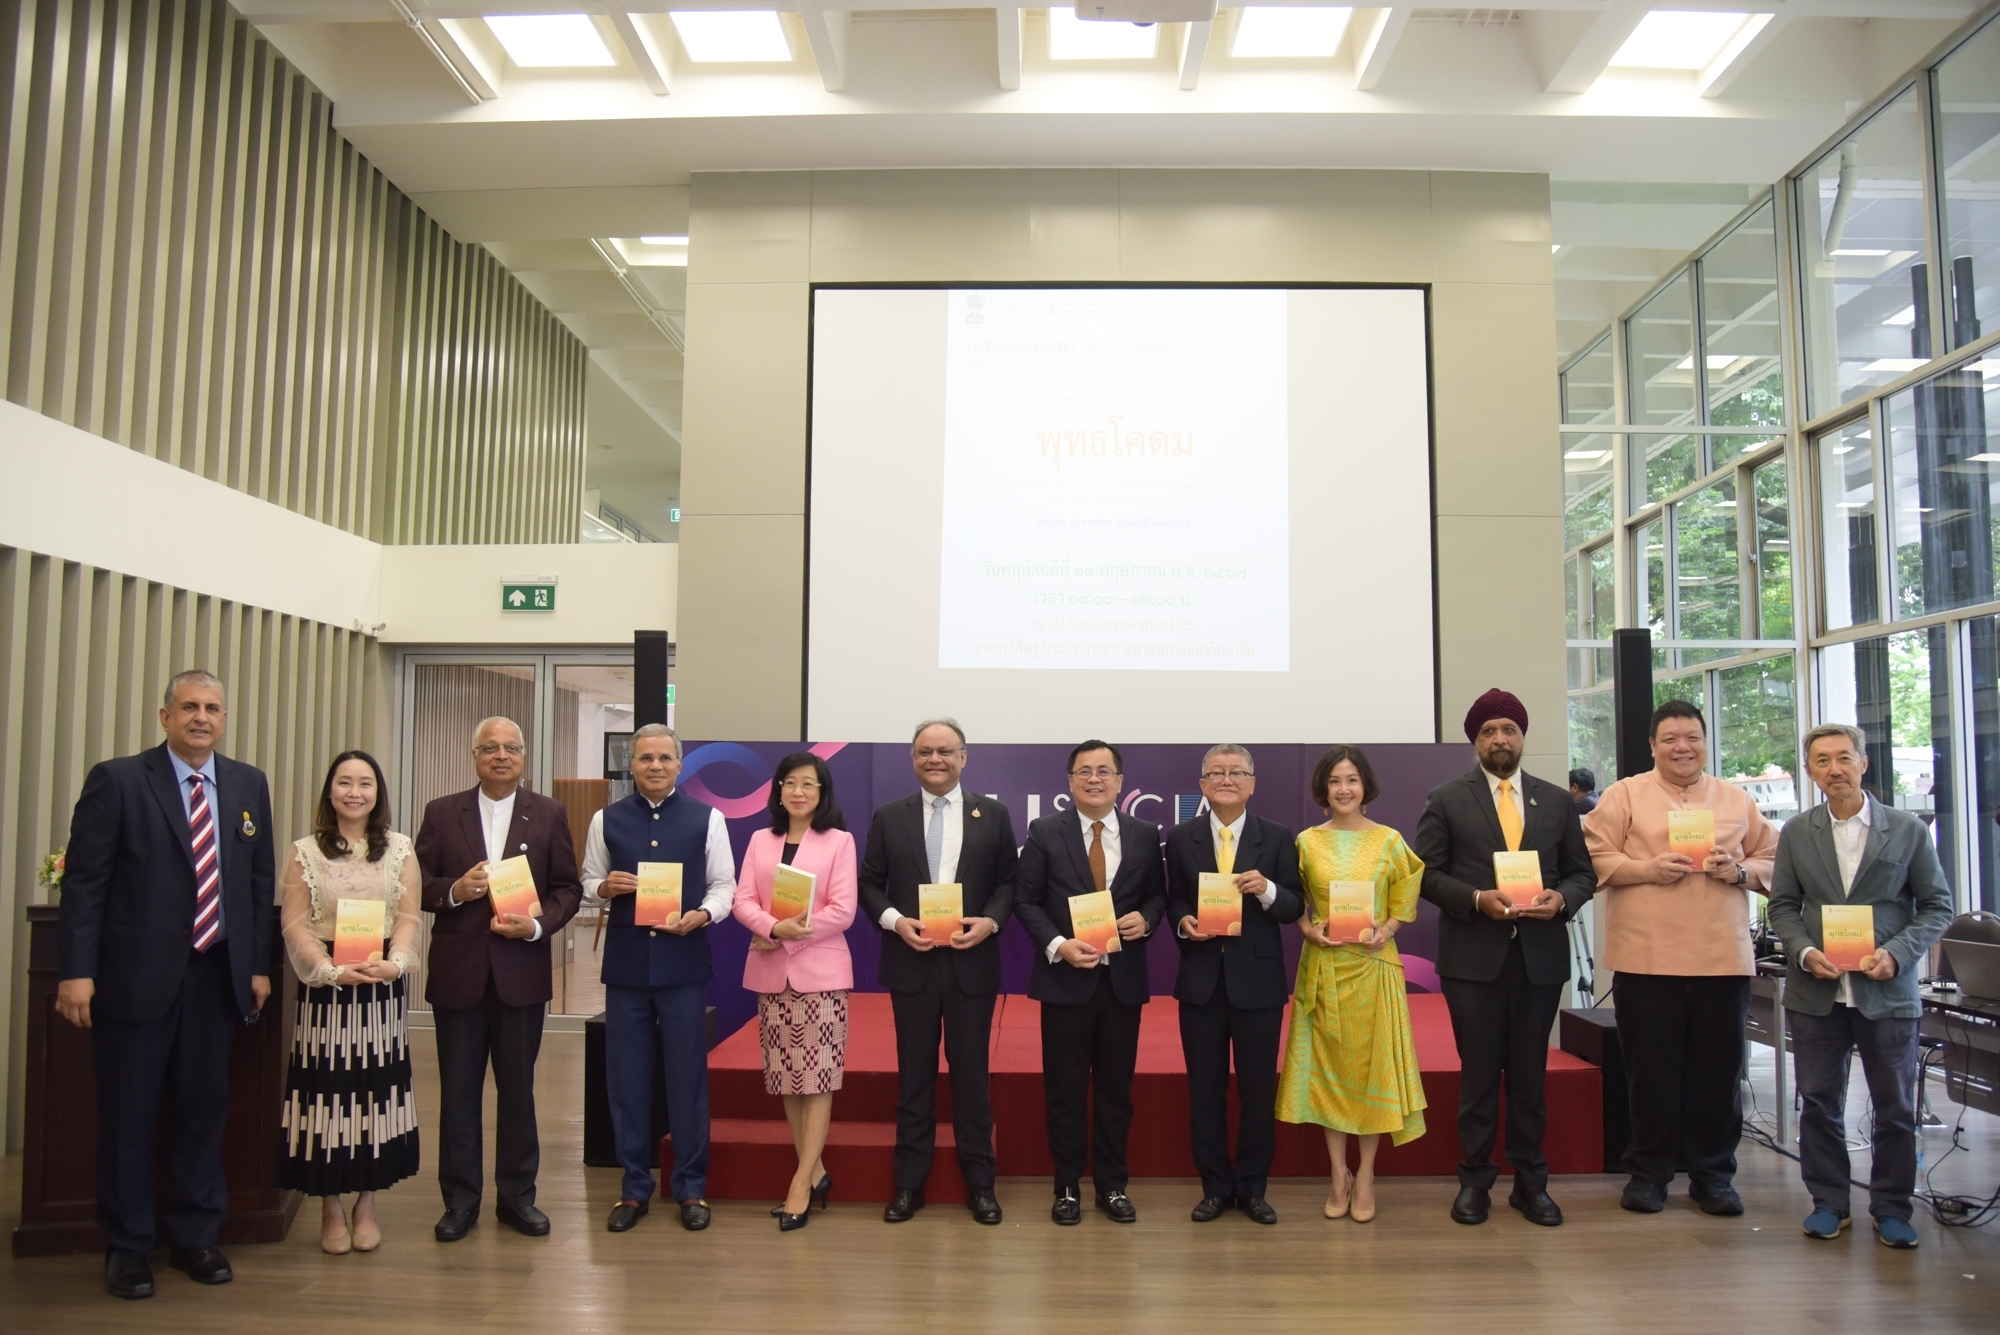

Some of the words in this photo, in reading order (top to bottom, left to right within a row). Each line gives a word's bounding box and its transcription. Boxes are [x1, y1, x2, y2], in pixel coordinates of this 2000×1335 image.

[966, 340, 1077, 357] งานต้อนรับศูนย์อินเดียฯ
[1081, 340, 1176, 357] สู่สถาบันเอเชียศึกษา
[1064, 391, 1167, 406] พร้อมเปิดตัวหนังสือ
[1035, 415, 1194, 471] พุทธโคดม
[982, 554, 1070, 581] วันพฤหัสบดีที่
[1073, 565, 1095, 577] ๒๓
[1098, 565, 1167, 582] พฤษภาคม
[1170, 565, 1199, 579] พ.ศ.
[1203, 565, 1248, 580] ๒๕๖๗
[1034, 592, 1065, 606] เวลา
[1068, 593, 1115, 606] ๐๙:๐๐
[1129, 593, 1176, 606] ๑๒:๐๐
[1179, 593, 1194, 607] น.
[1034, 619, 1045, 631] ณ
[1048, 617, 1065, 631] CU
[1068, 617, 1102, 631] Social
[1106, 618, 1168, 632] Innovation
[1171, 618, 1194, 632] Hub
[974, 638, 1039, 659] อาคารวิศิษฐ์
[1043, 641, 1121, 656] ประจวบเหมาะ
[1125, 640, 1255, 660] จุฬาลงกรณ์มหาวิทยาลัย
